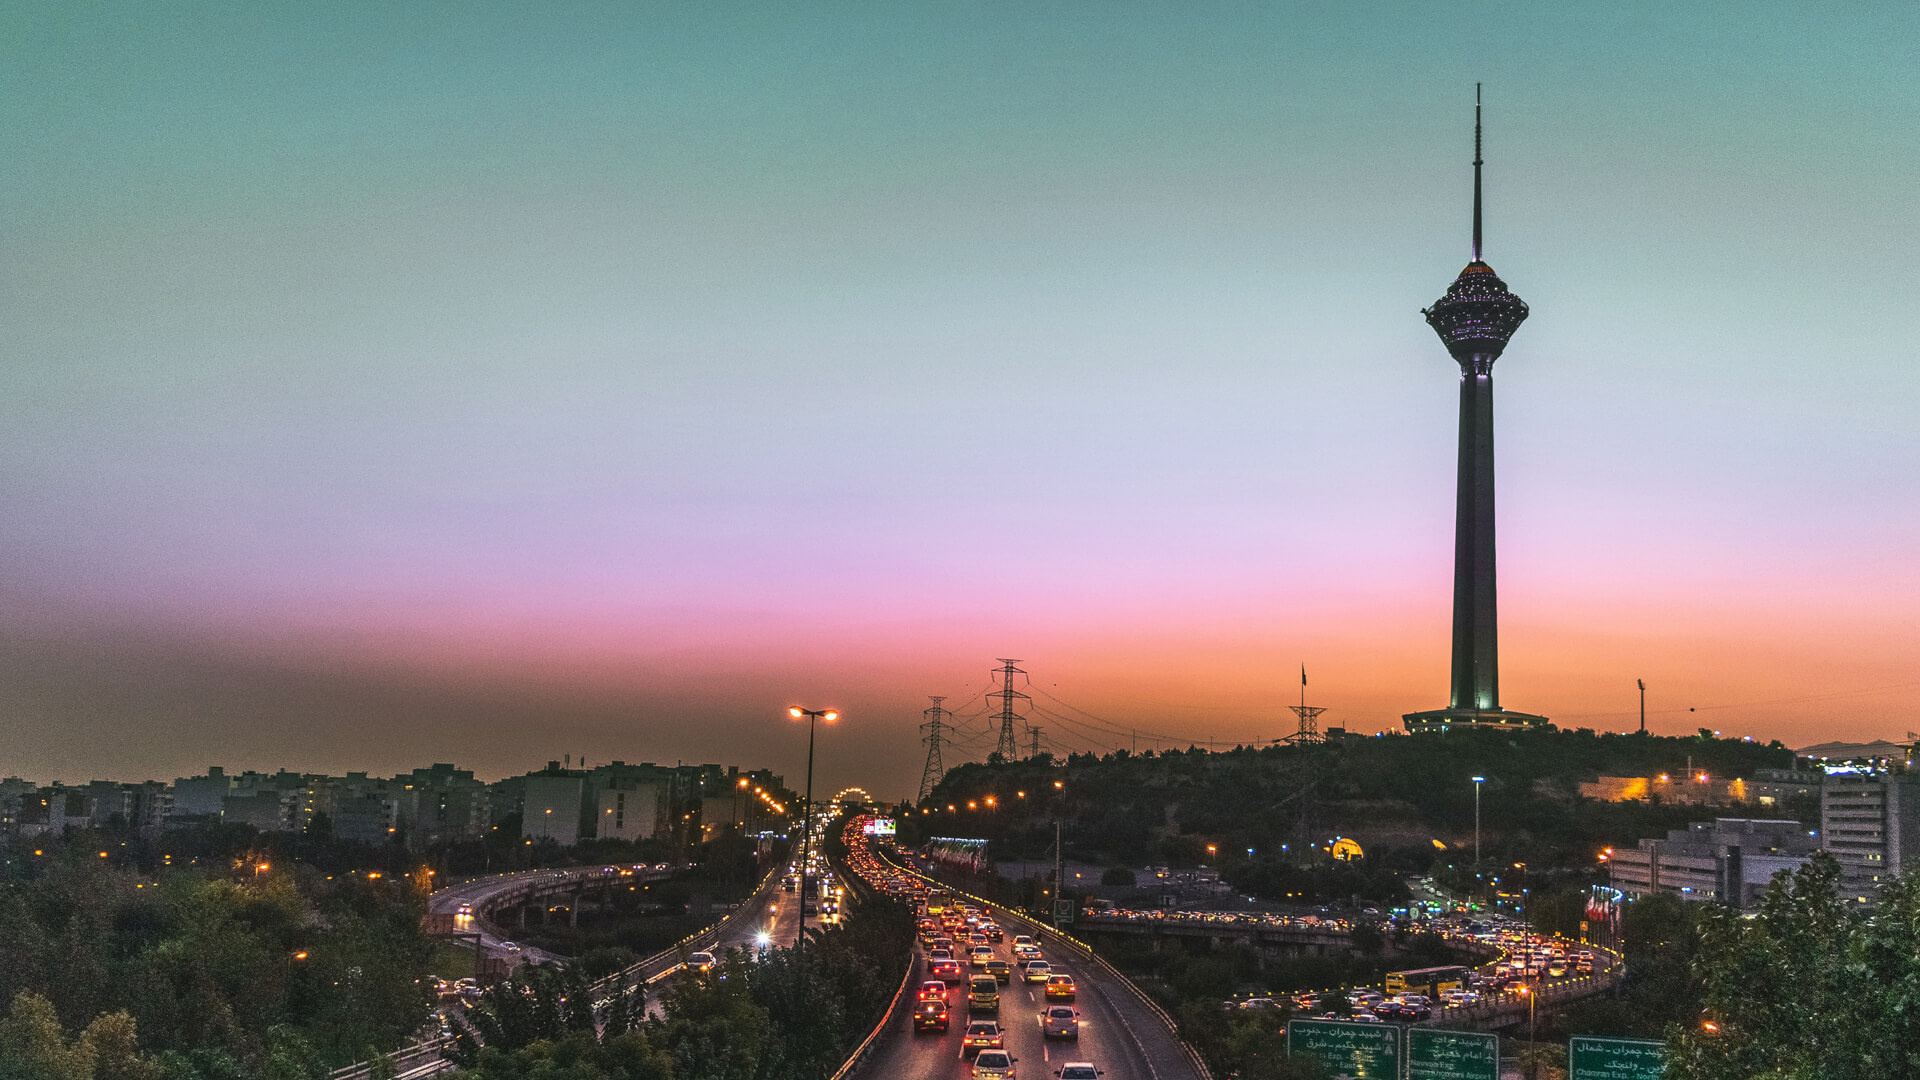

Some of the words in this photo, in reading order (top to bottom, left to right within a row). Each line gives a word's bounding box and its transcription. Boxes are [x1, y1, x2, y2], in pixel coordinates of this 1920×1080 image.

[1294, 1027, 1321, 1036] جنوب
[1328, 1028, 1356, 1039] چمران
[1358, 1029, 1382, 1038] شهید
[1306, 1038, 1327, 1049] شرق
[1334, 1040, 1356, 1051] حکیم
[1359, 1043, 1382, 1051] شهید
[1459, 1037, 1482, 1047] شهید
[1577, 1043, 1604, 1052] شمال
[1612, 1045, 1642, 1058] چمران
[1463, 1051, 1482, 1061] امام
[1604, 1060, 1638, 1072] ولنجک
[1576, 1068, 1610, 1078] Chamran
